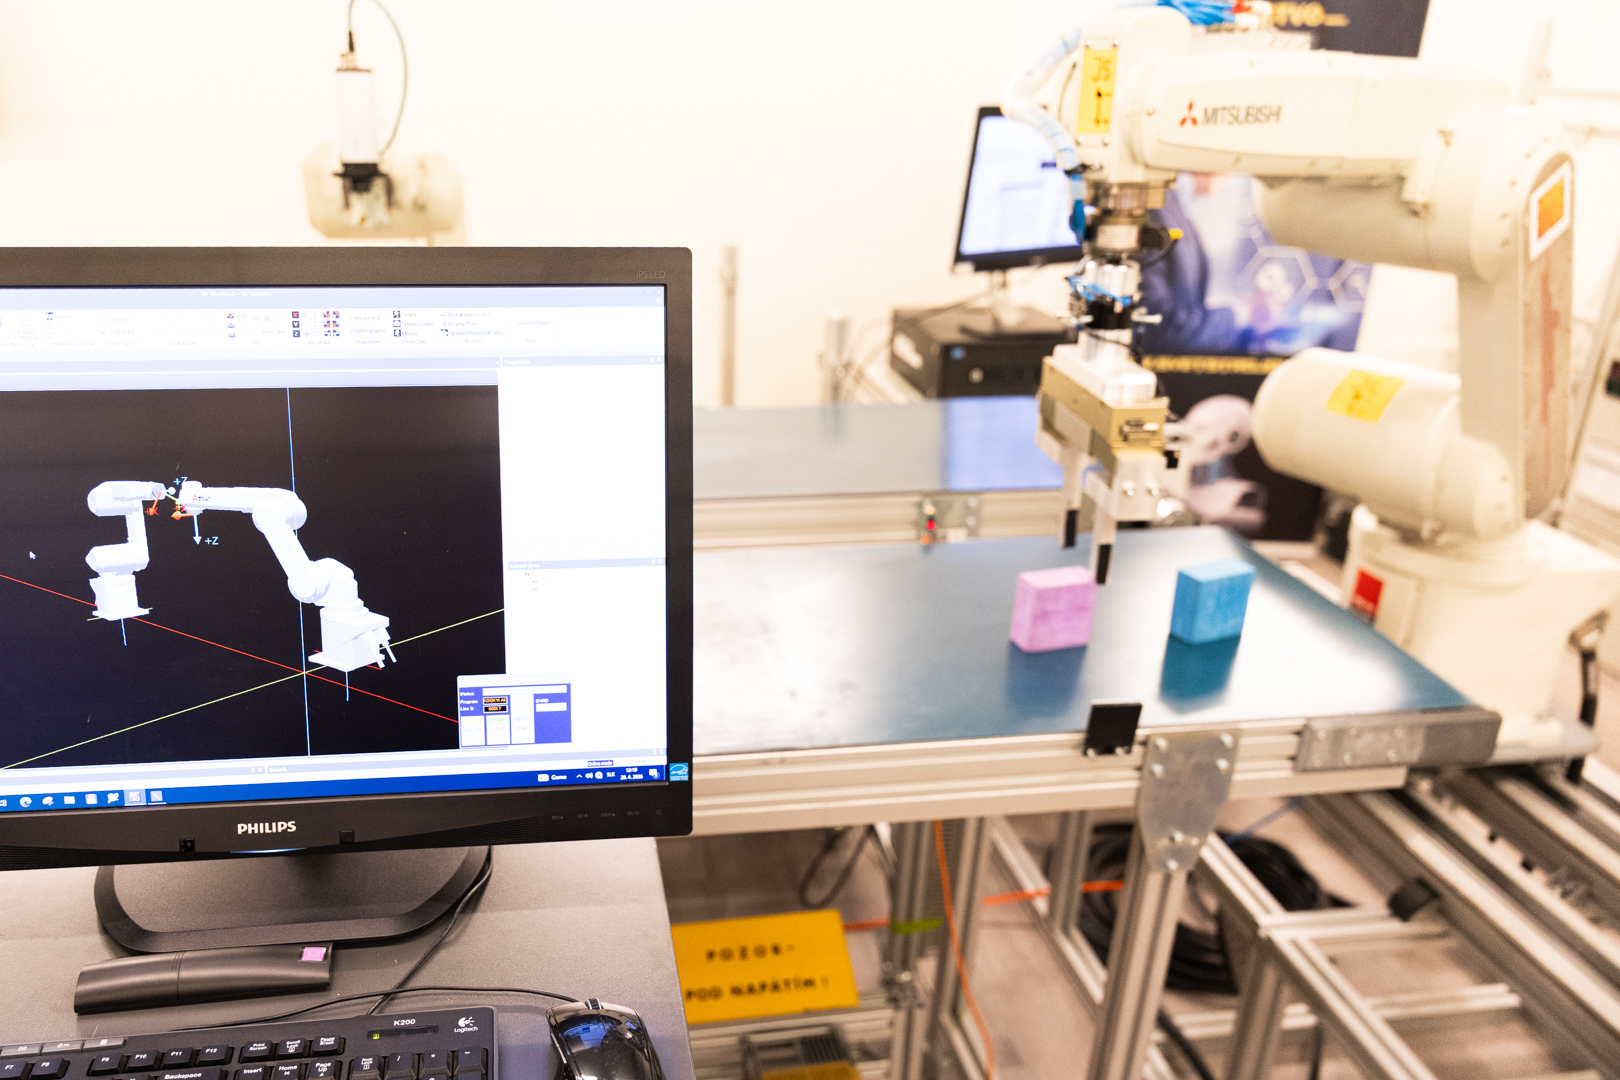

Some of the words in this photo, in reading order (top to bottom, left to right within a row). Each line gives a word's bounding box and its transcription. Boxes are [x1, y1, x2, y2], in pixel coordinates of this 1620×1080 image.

[204, 536, 219, 545] +Z
[237, 820, 297, 835] PHILIPS
[393, 1018, 416, 1027] K200
[453, 1025, 479, 1034] Logitech
[164, 1072, 203, 1080] Backspace
